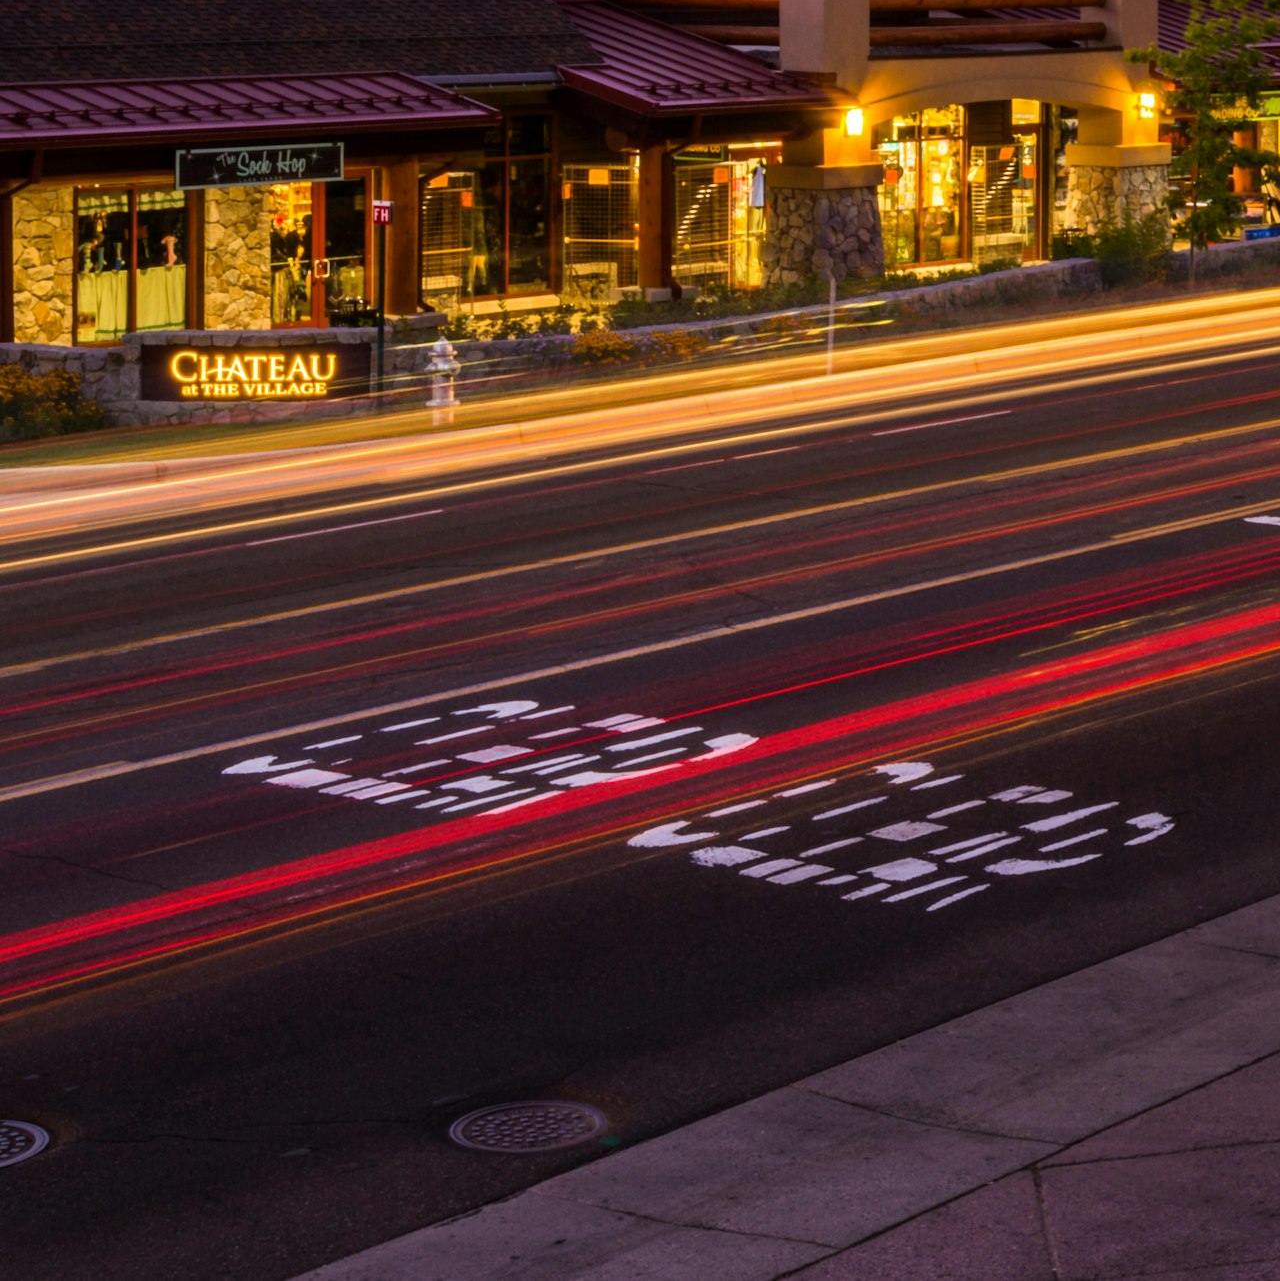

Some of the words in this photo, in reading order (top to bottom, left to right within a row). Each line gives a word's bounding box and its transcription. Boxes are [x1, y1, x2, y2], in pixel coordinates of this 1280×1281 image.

[236, 151, 272, 176] Sock
[276, 149, 306, 178] Hop
[374, 208, 389, 222] FH
[182, 385, 198, 396] at
[201, 383, 239, 396] THE
[240, 382, 328, 396] VILLAGE
